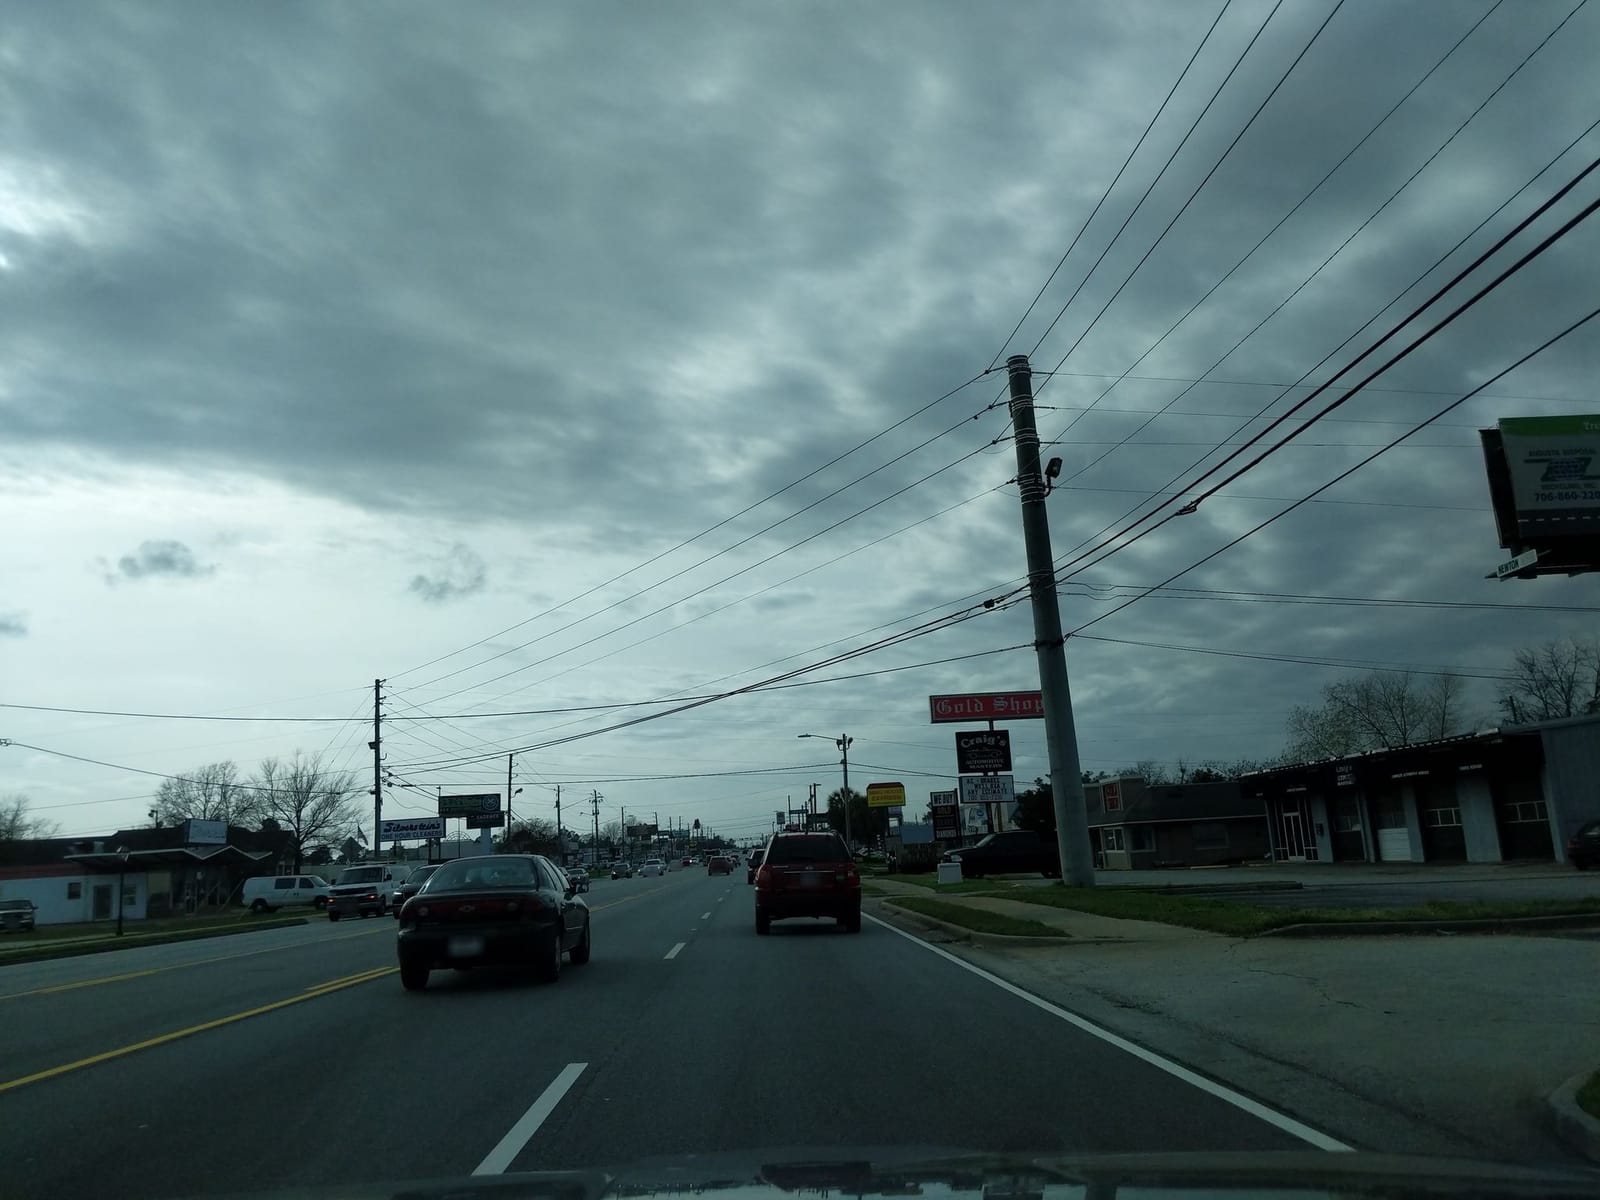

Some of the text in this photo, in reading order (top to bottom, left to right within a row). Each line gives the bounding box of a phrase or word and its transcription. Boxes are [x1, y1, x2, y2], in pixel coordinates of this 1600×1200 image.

[1498, 559, 1519, 575] NEWTON
[936, 698, 984, 714] Gold
[960, 734, 1007, 748] Craig's
[413, 830, 442, 838] CLEANERS
